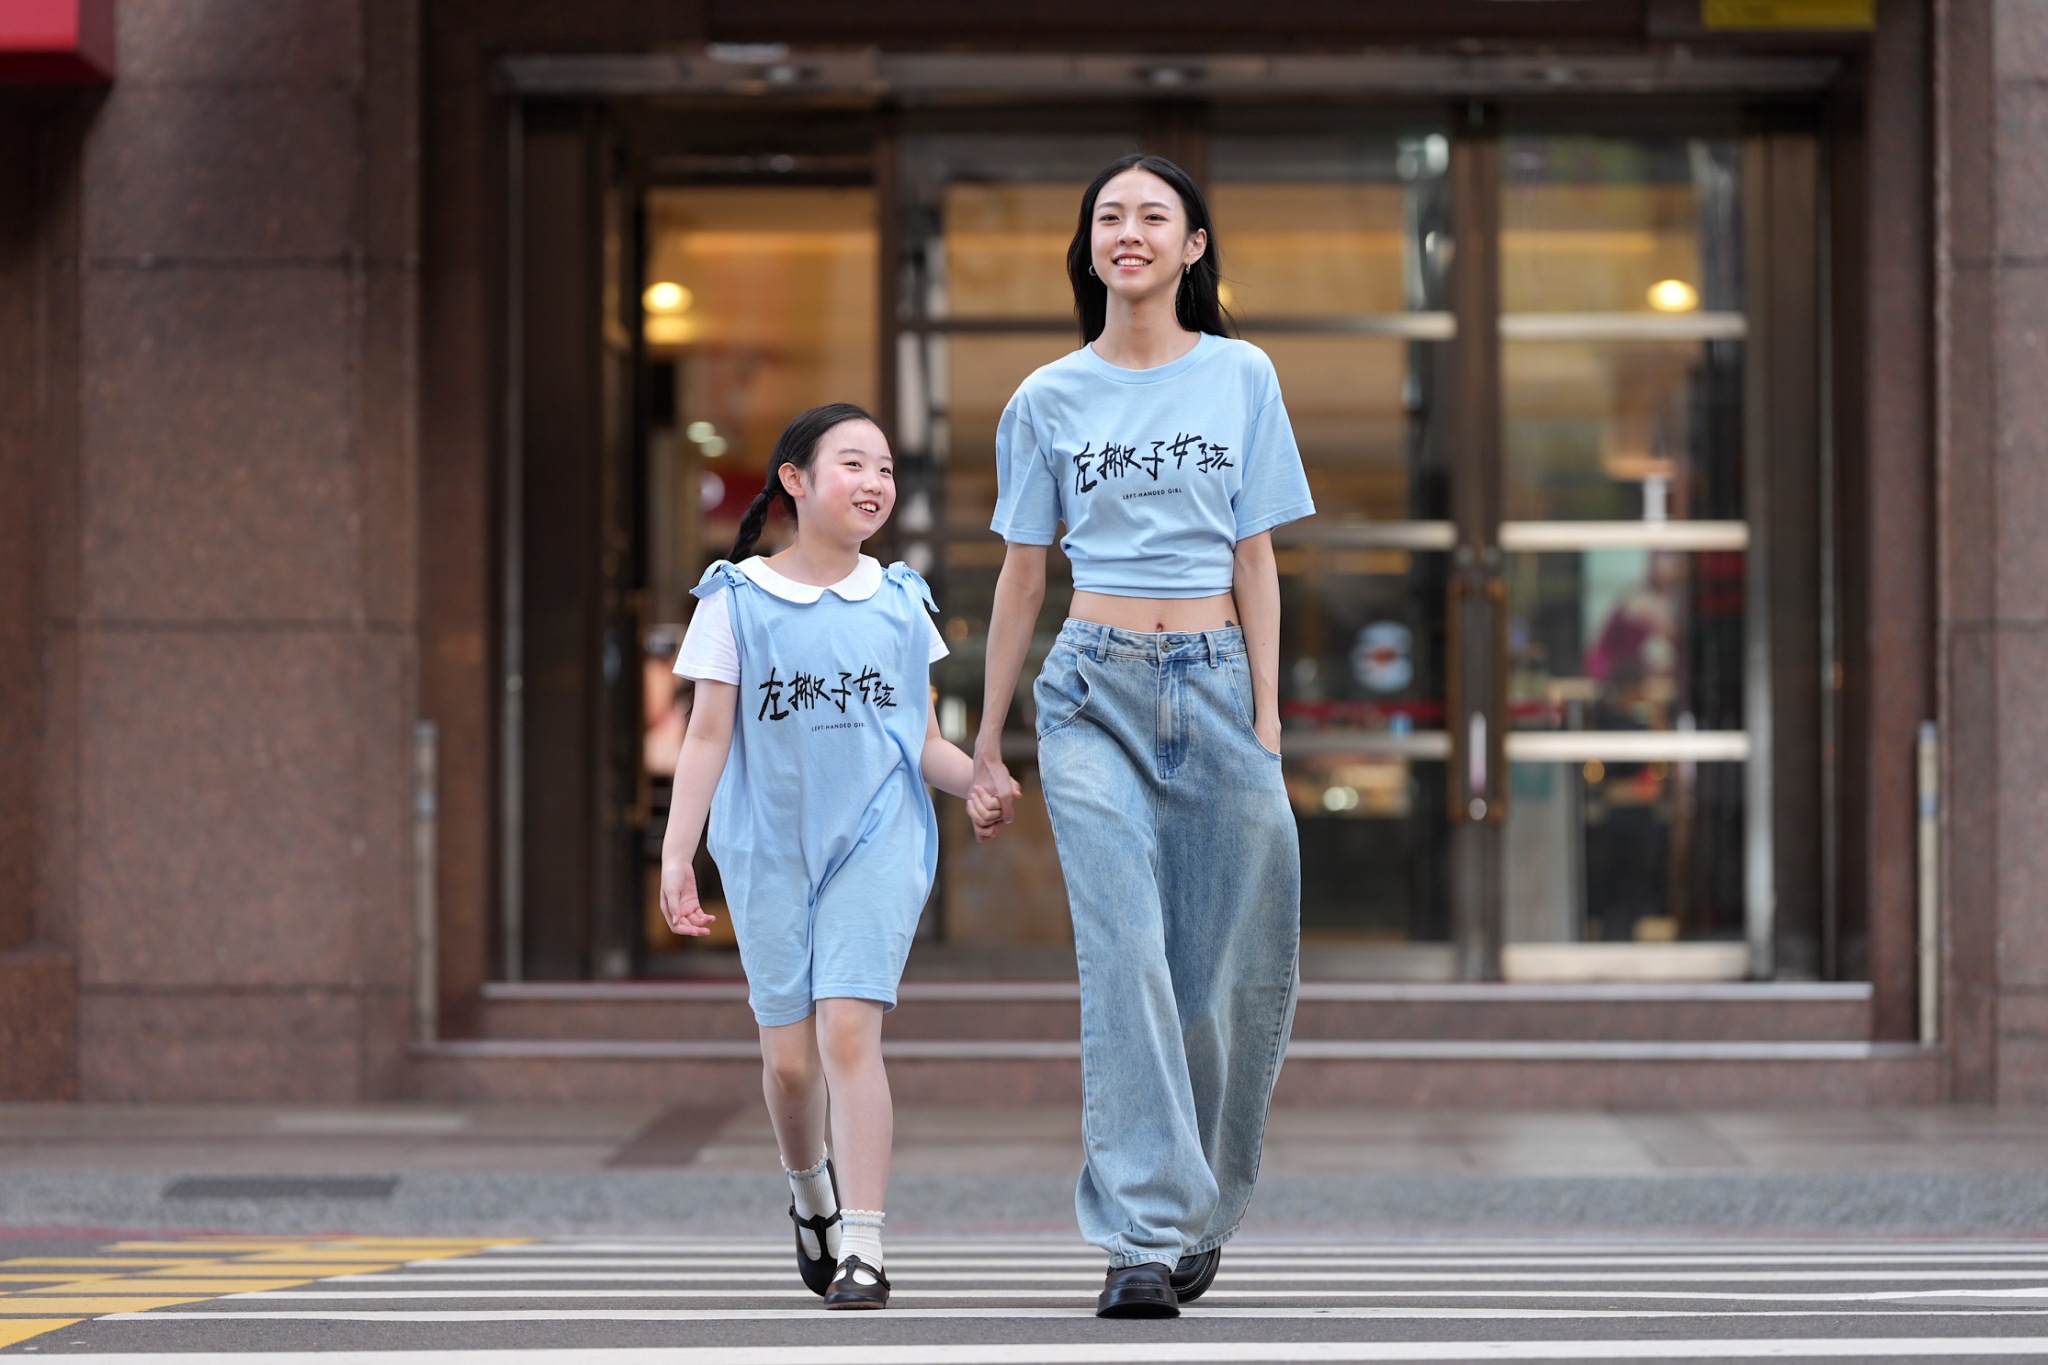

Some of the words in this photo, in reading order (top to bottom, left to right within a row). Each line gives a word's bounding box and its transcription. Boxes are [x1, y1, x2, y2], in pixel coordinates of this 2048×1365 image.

[1073, 432, 1234, 496] 左撇子女孩
[1122, 489, 1166, 500] LEFT-HANDED
[758, 664, 897, 721] 左撇子女孩
[811, 722, 852, 732] LEFT-HANDED
